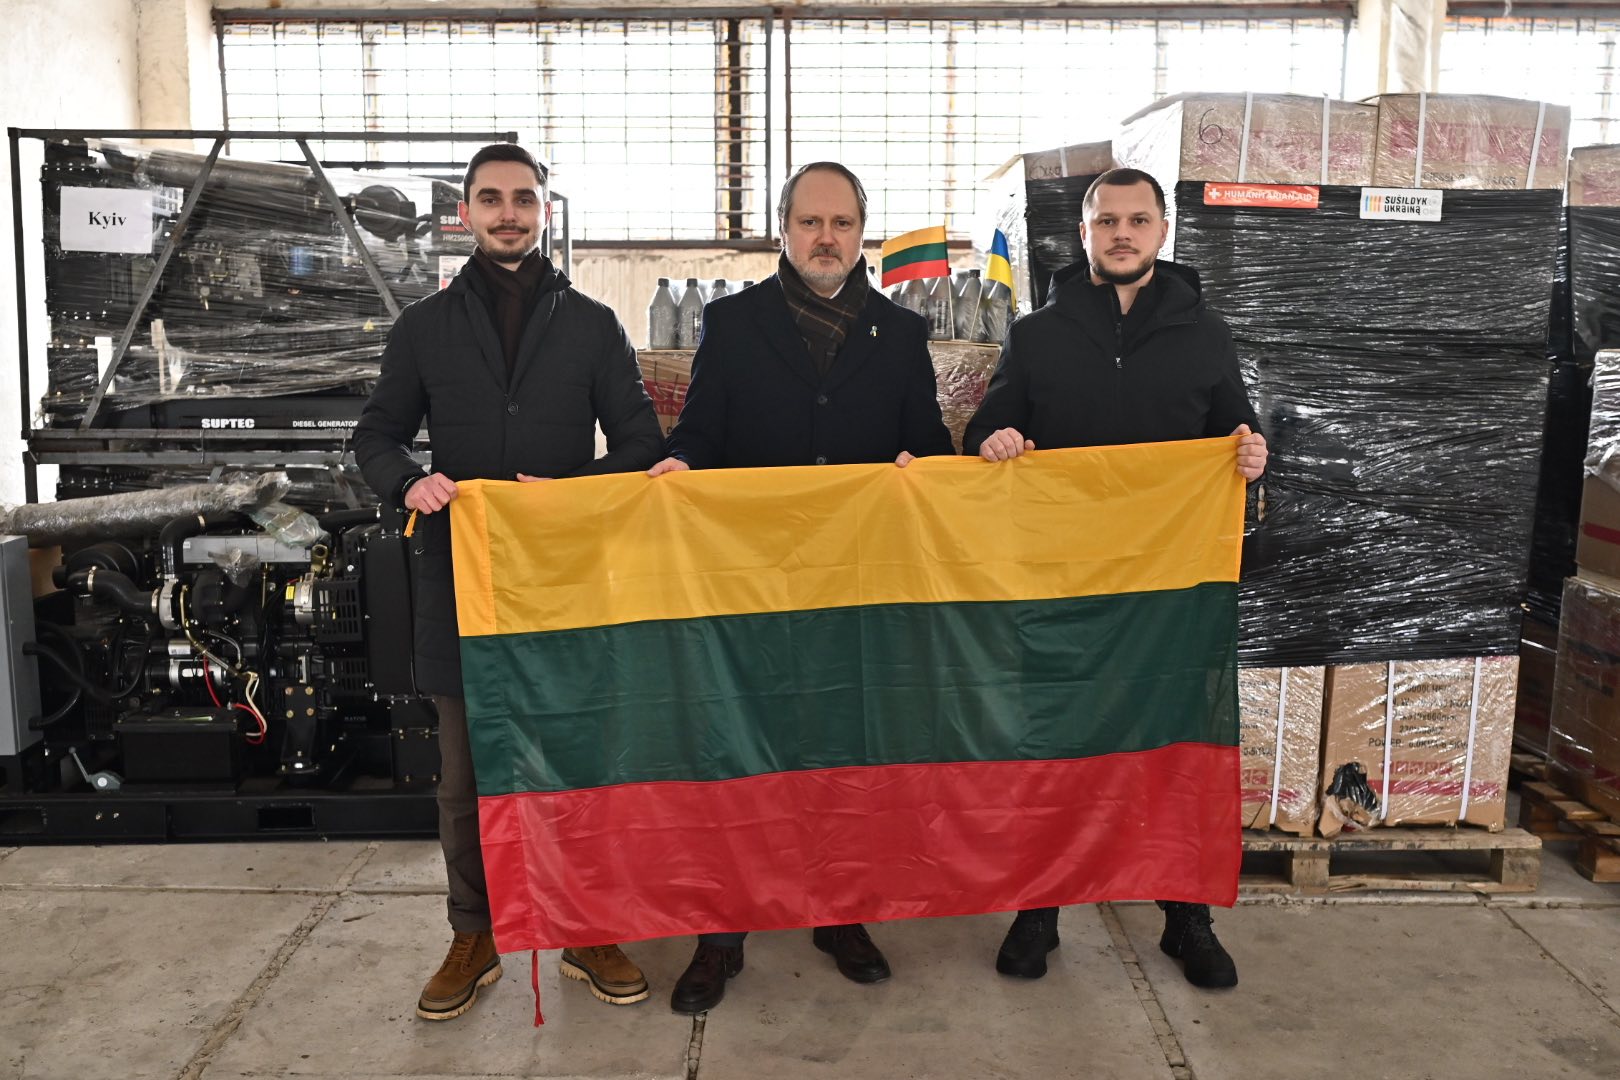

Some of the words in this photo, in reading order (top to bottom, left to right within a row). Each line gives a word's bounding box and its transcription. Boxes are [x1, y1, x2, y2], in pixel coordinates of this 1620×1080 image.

[1199, 107, 1224, 145] 6
[1224, 189, 1295, 200] HUMANITARIAN
[1296, 192, 1313, 201] AID
[88, 211, 127, 230] Kyiv
[201, 417, 255, 429] SUPTEC
[292, 420, 317, 428] DIESEL
